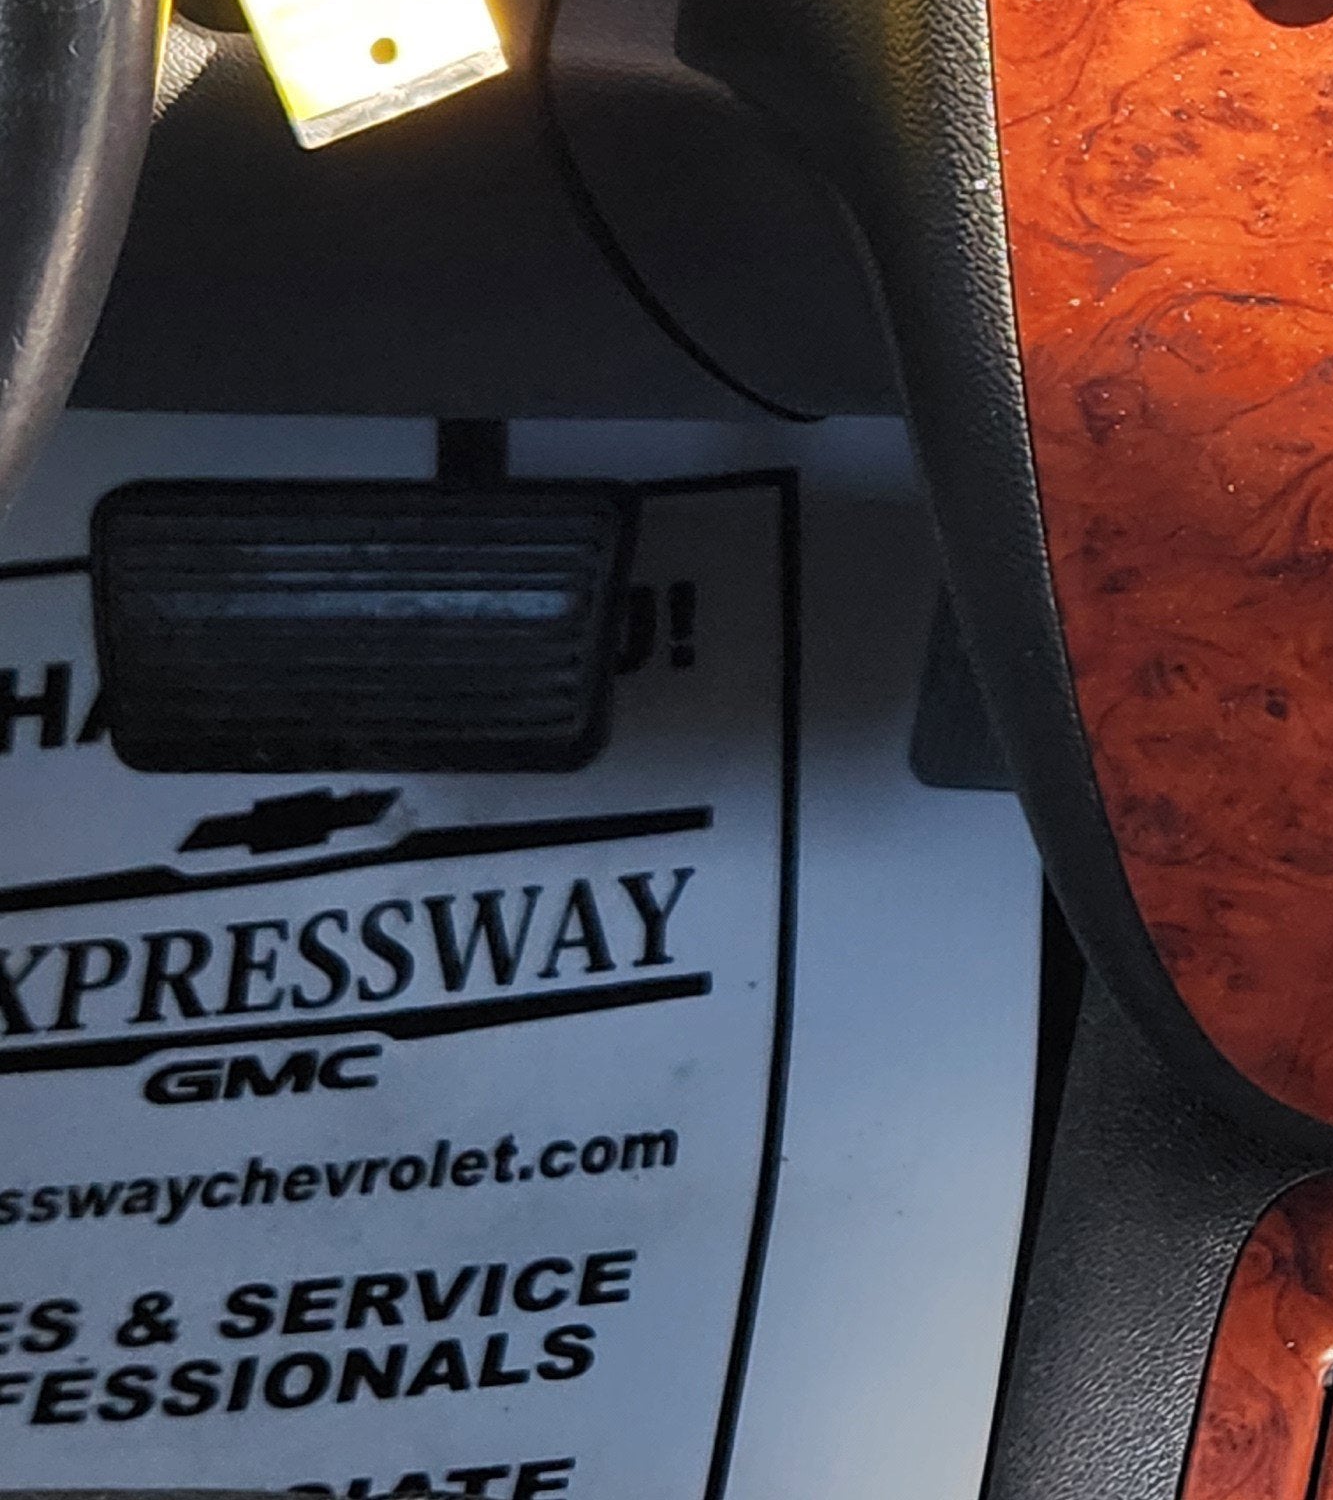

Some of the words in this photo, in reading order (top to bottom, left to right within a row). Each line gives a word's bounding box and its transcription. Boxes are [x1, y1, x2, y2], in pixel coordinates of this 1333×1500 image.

[144, 1044, 382, 1105] GMC
[116, 1291, 178, 1349] &
[217, 1249, 638, 1341] SERVICE
